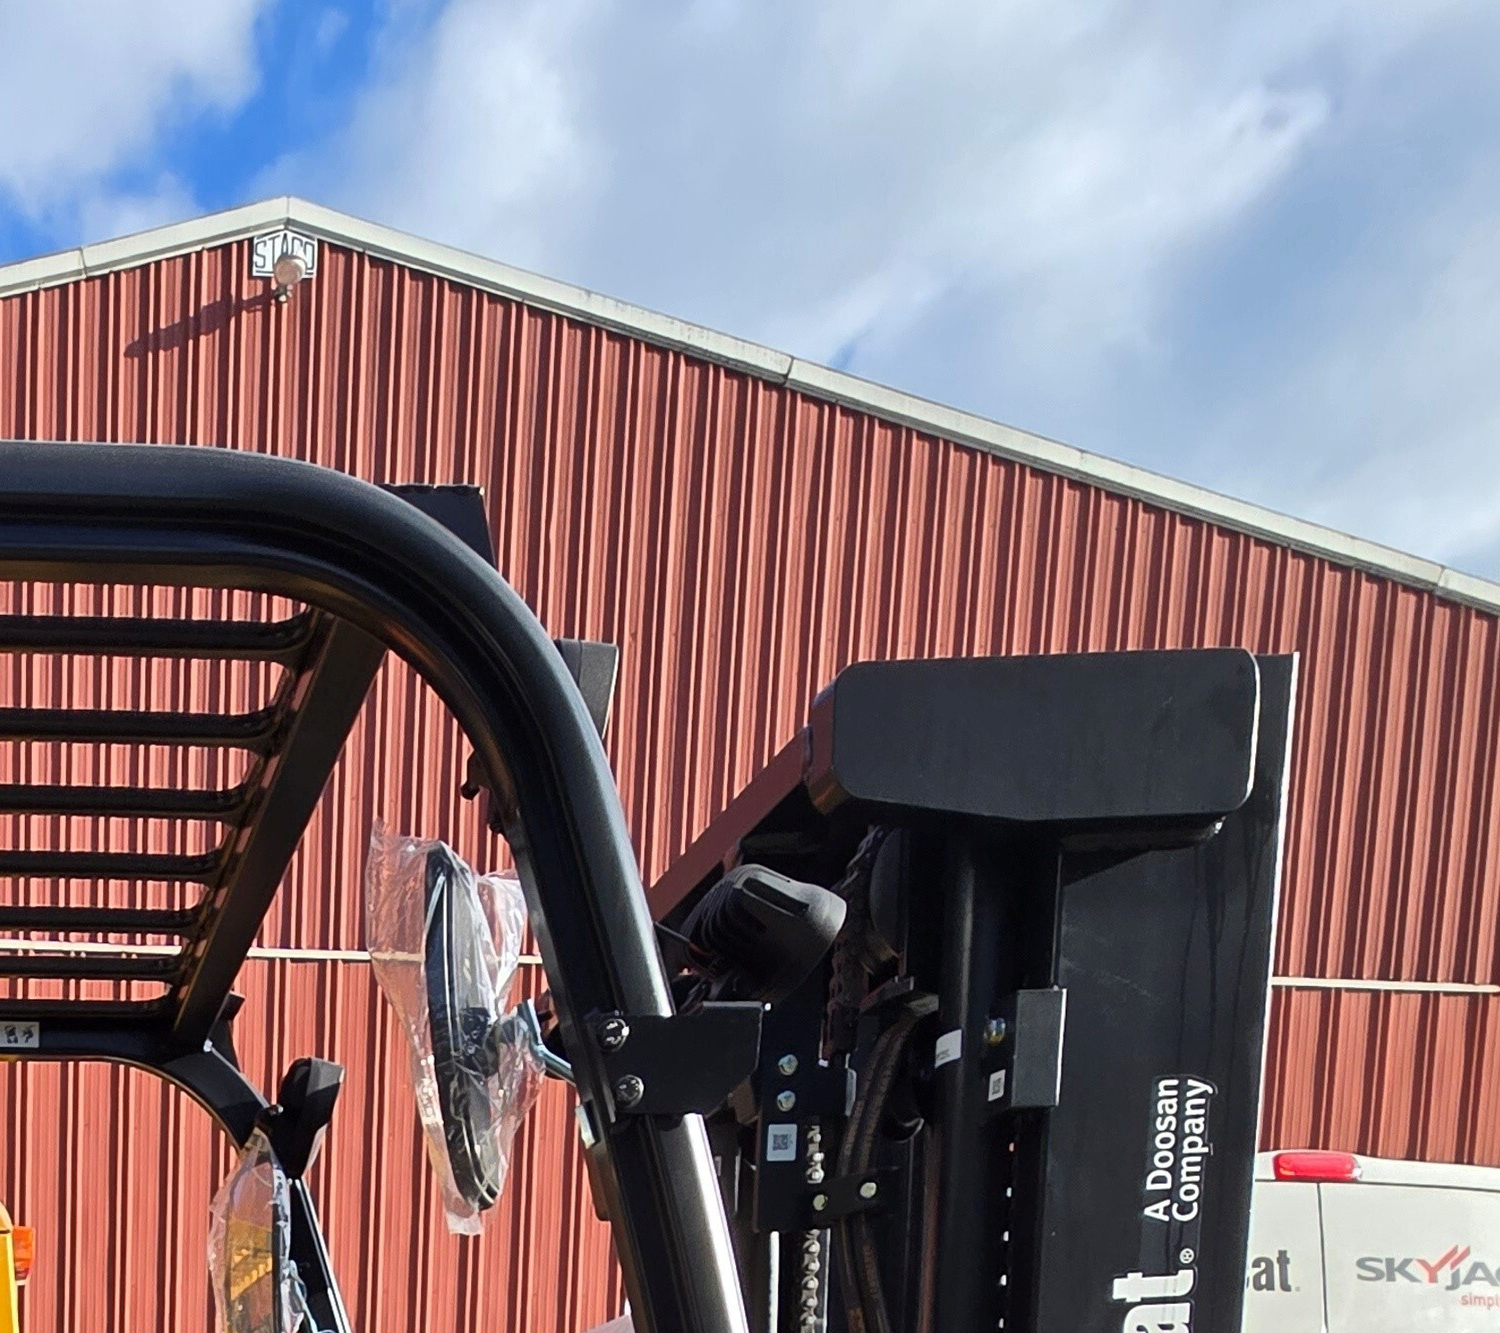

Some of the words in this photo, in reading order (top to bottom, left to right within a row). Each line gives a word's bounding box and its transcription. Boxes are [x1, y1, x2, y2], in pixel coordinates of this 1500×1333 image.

[1146, 1079, 1180, 1190] Doosan
[1171, 1079, 1214, 1222] Company
[1144, 1199, 1171, 1222] A
[1356, 1244, 1500, 1291] SKYJA
[1461, 1293, 1500, 1310] simpl
